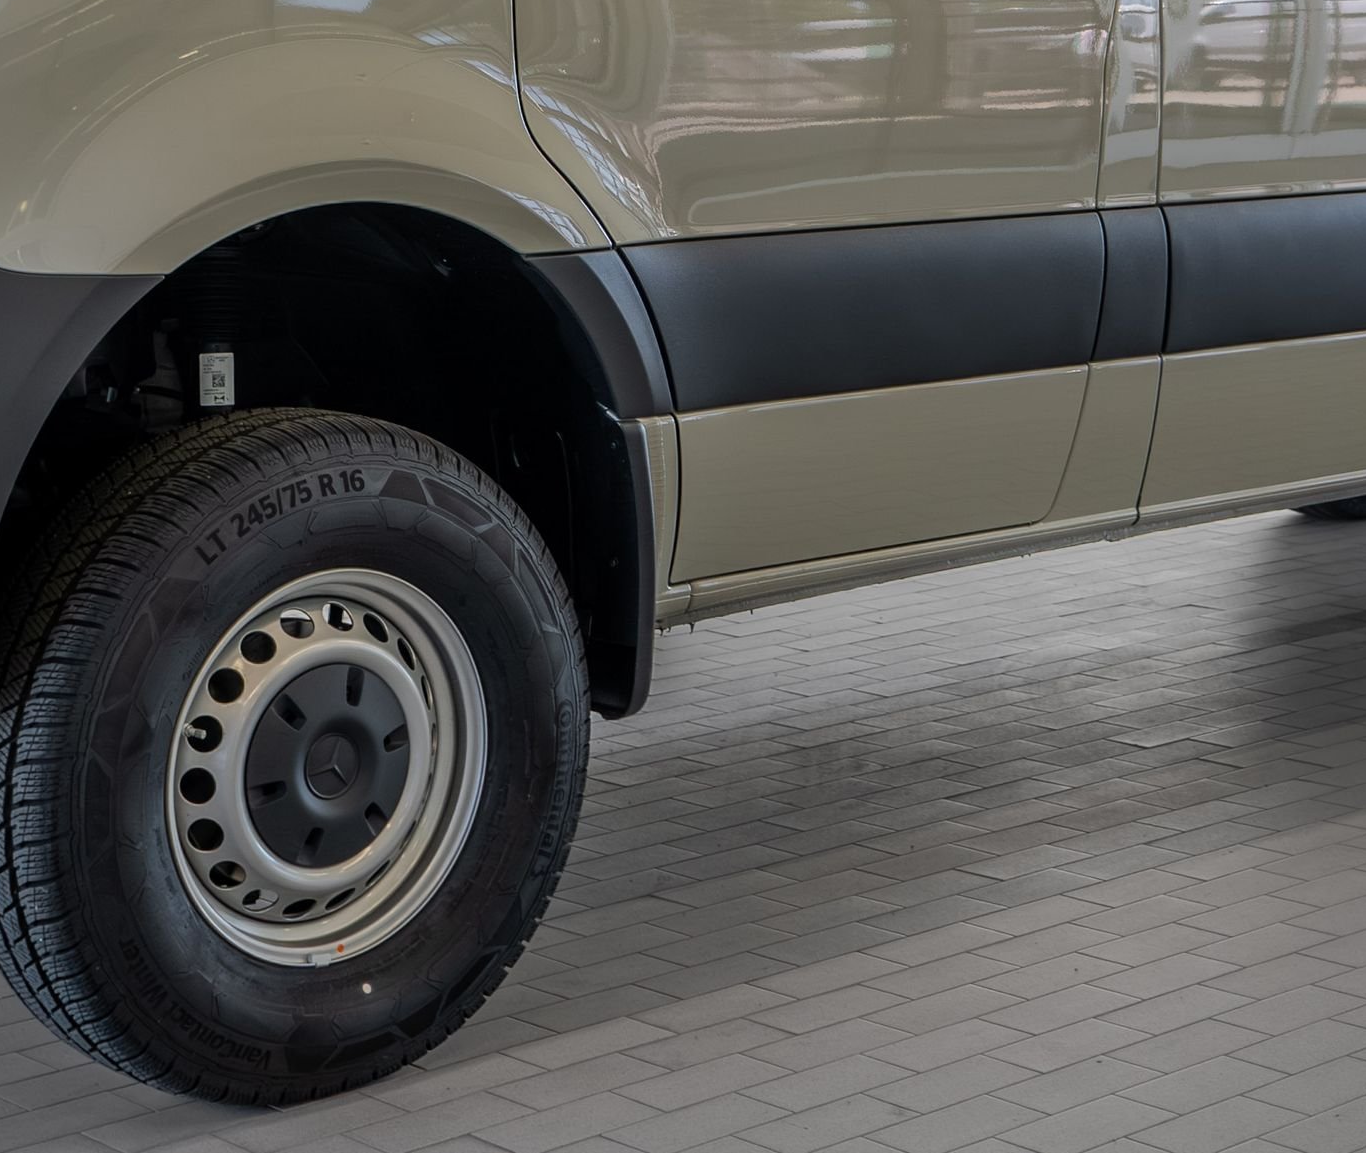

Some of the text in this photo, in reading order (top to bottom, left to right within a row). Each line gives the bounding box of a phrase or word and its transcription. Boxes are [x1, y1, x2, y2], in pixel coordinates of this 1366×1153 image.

[194, 469, 366, 566] LT 245/75 R 16
[538, 699, 575, 860] Continental
[117, 938, 273, 1070] VanContact Winter
